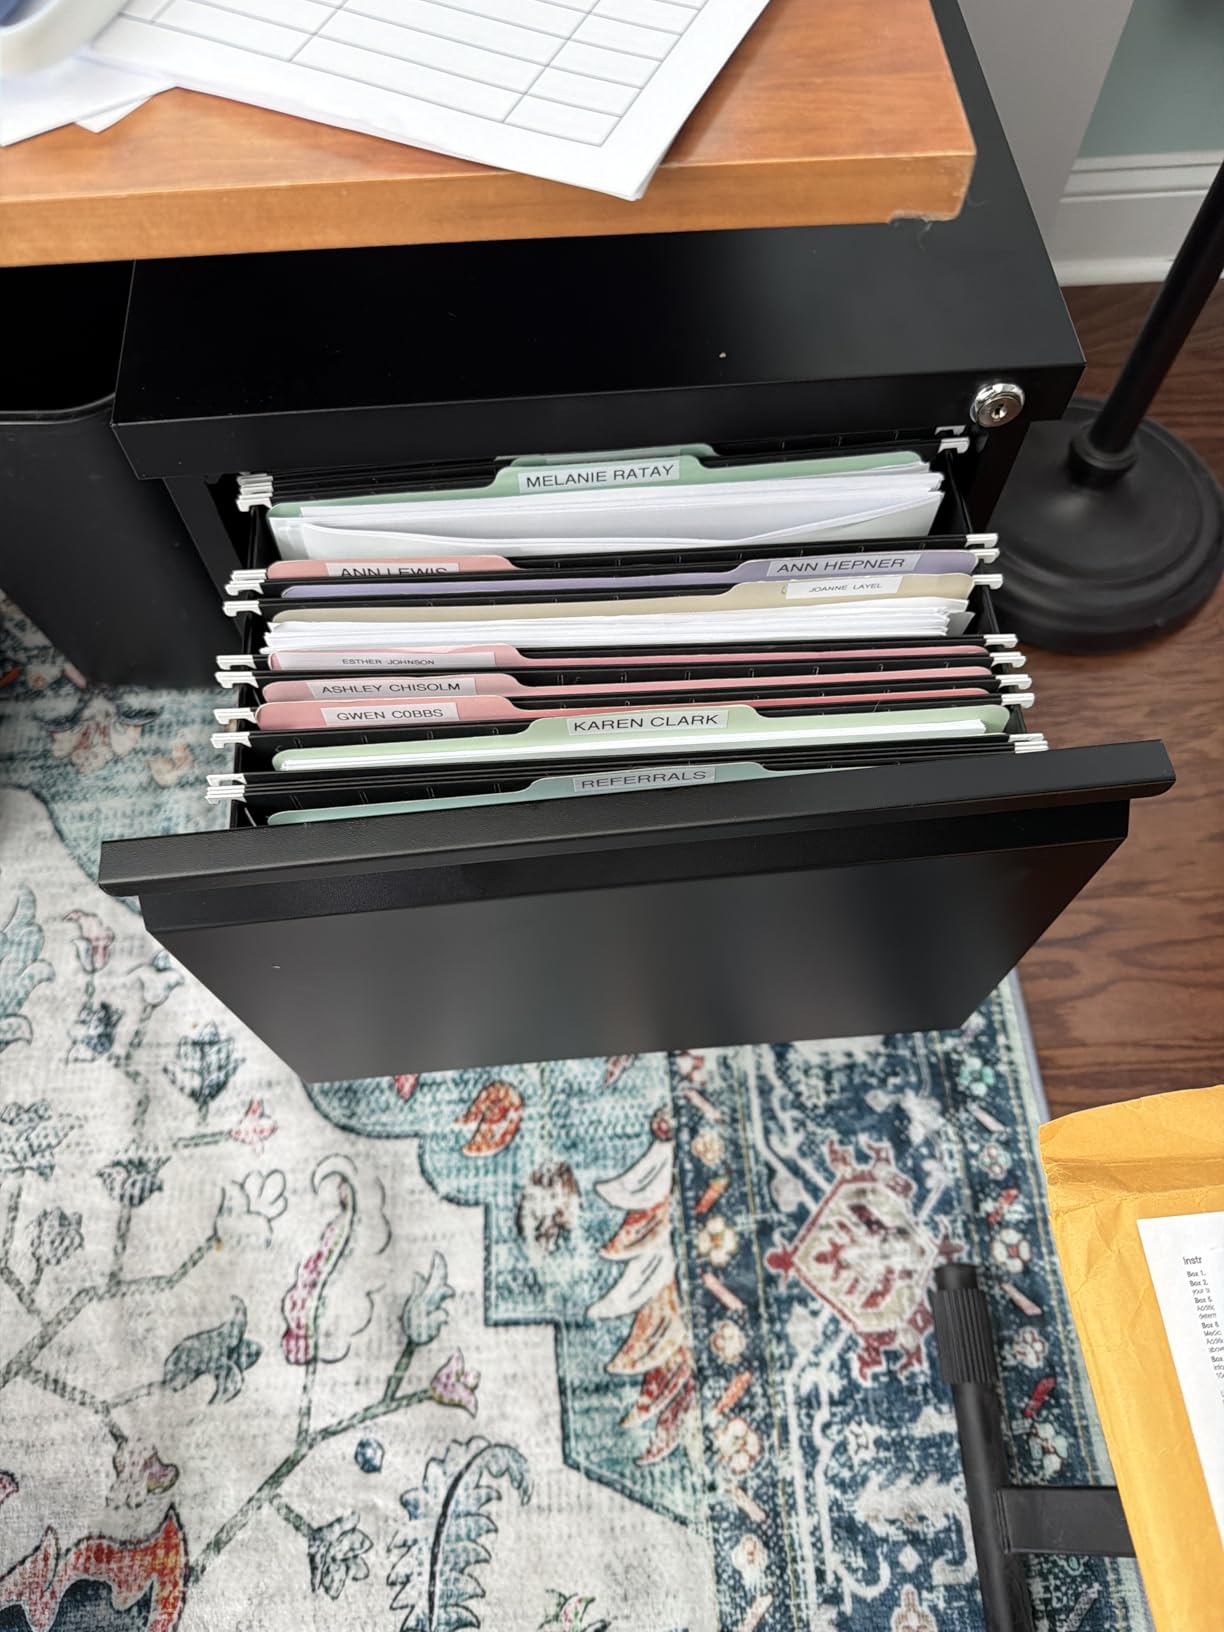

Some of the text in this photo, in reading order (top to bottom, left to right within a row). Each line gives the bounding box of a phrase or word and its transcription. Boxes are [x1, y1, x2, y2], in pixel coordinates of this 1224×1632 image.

[525, 464, 675, 489] MELANIE RATAY
[776, 558, 906, 573] ANN HEPNER
[341, 567, 381, 577] ANN
[808, 584, 848, 593] JOANNE
[387, 658, 435, 666] JOHNSON
[322, 682, 461, 694] ASHLEY CHISOLM
[336, 711, 386, 721] GWEN
[574, 714, 719, 732] KAREN CLARK
[581, 771, 707, 789] REFERRALS
